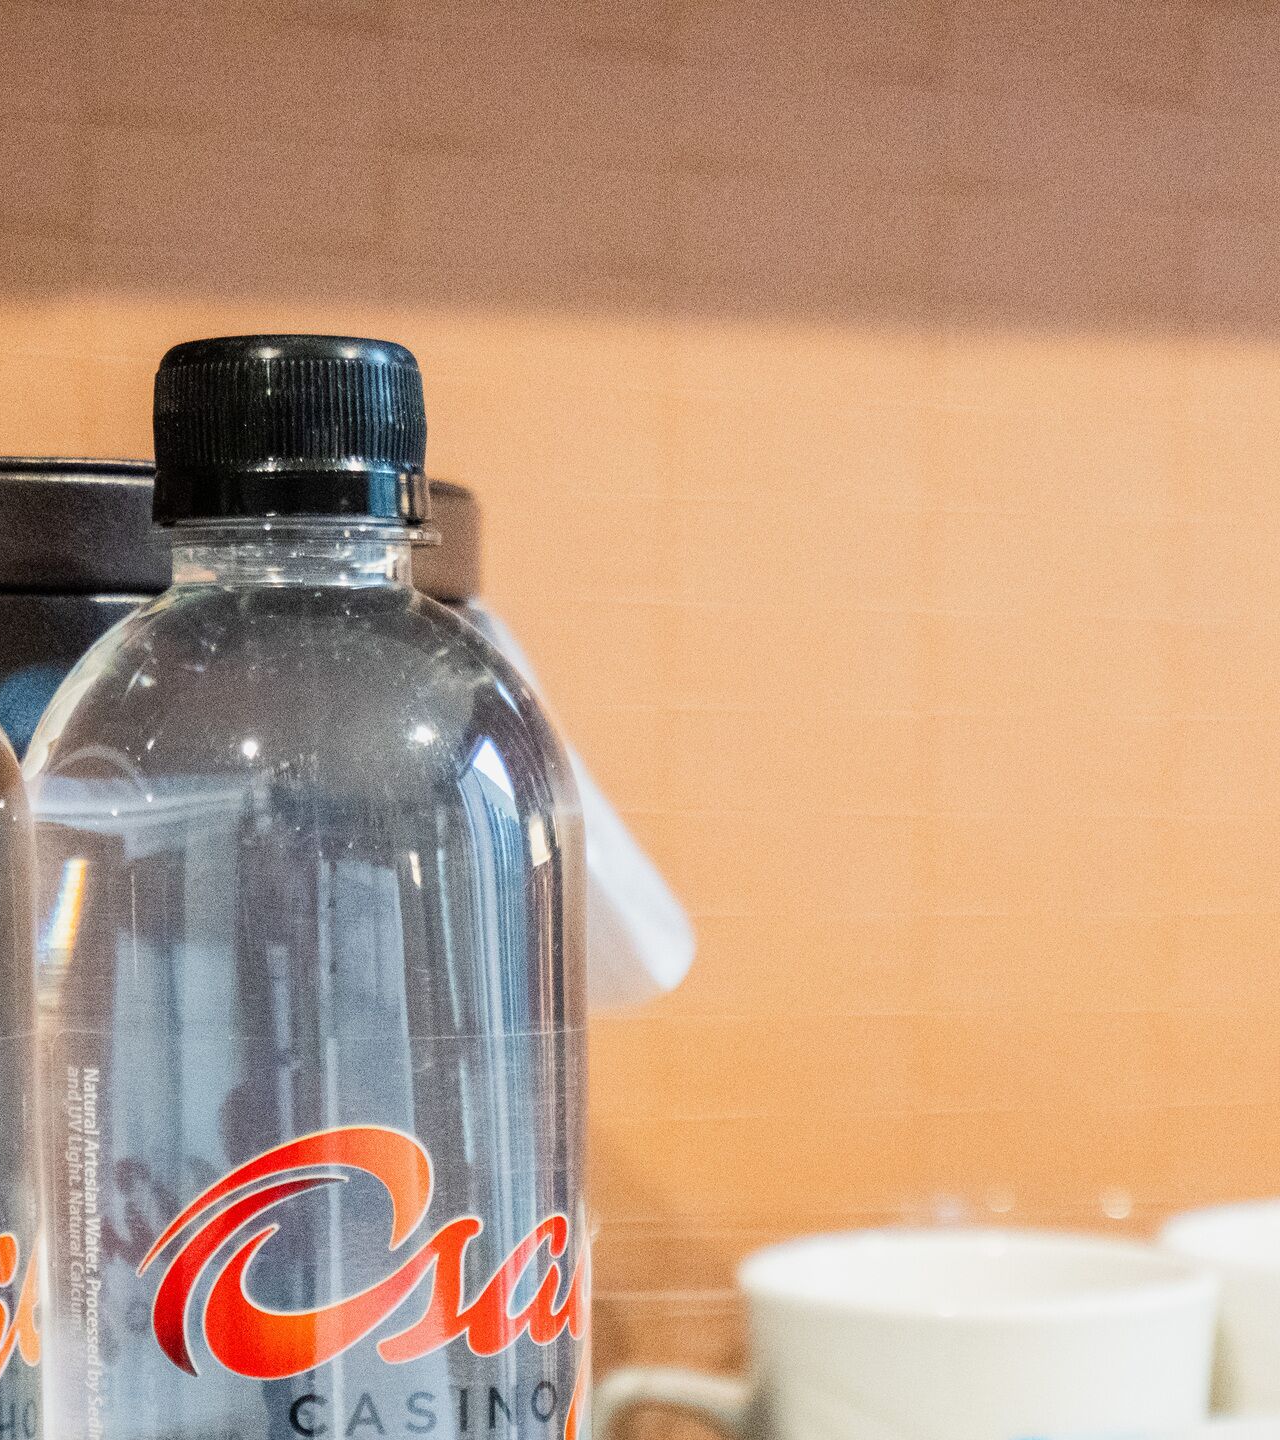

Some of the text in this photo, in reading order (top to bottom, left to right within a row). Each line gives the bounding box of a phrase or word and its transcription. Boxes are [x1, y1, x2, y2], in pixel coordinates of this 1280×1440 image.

[84, 1066, 101, 1136] Natural
[84, 1138, 101, 1213] Artesian
[68, 1190, 85, 1258] Natural
[85, 1279, 103, 1367] Processed
[84, 1369, 103, 1393] by
[288, 1380, 557, 1438] CASINO
